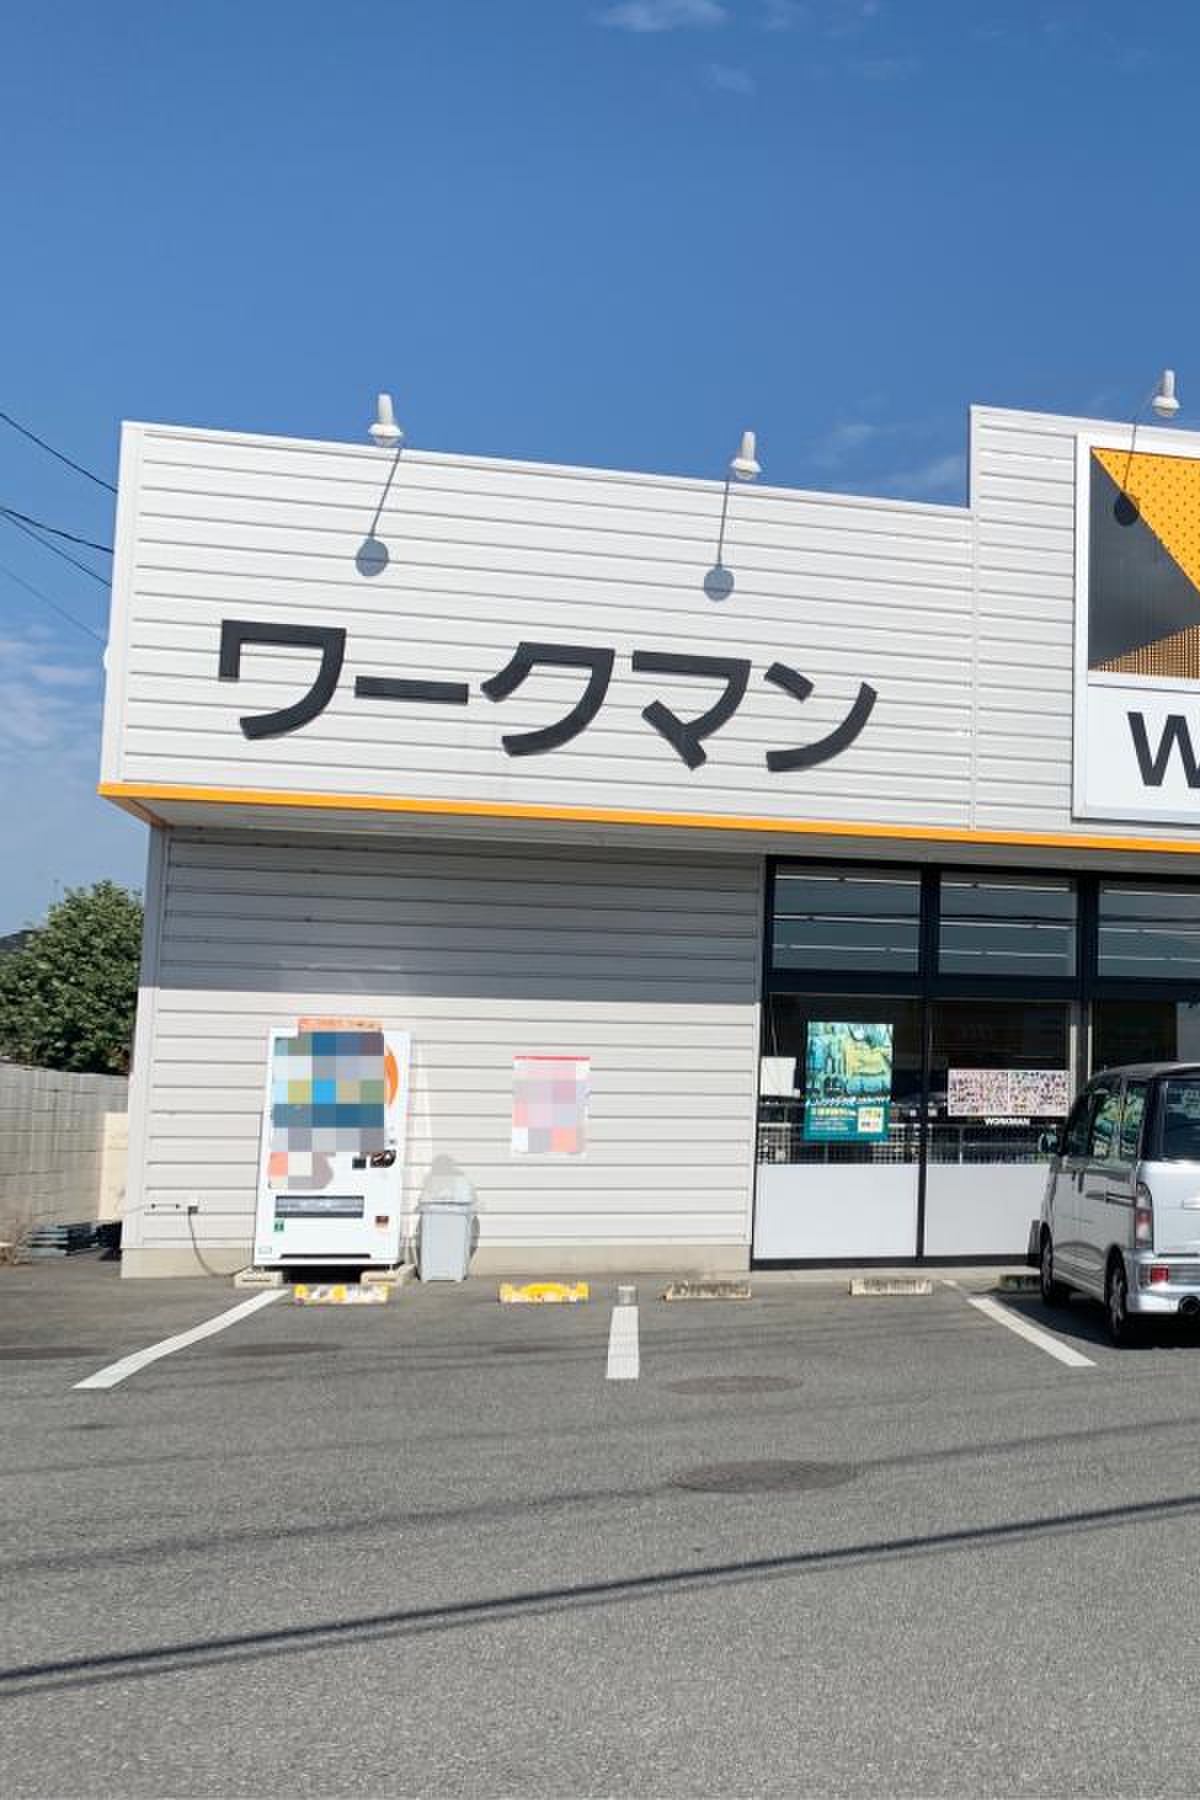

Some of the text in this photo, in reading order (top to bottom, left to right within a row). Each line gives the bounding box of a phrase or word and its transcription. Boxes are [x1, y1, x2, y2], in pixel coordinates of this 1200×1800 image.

[218, 618, 877, 773] ワークマン
